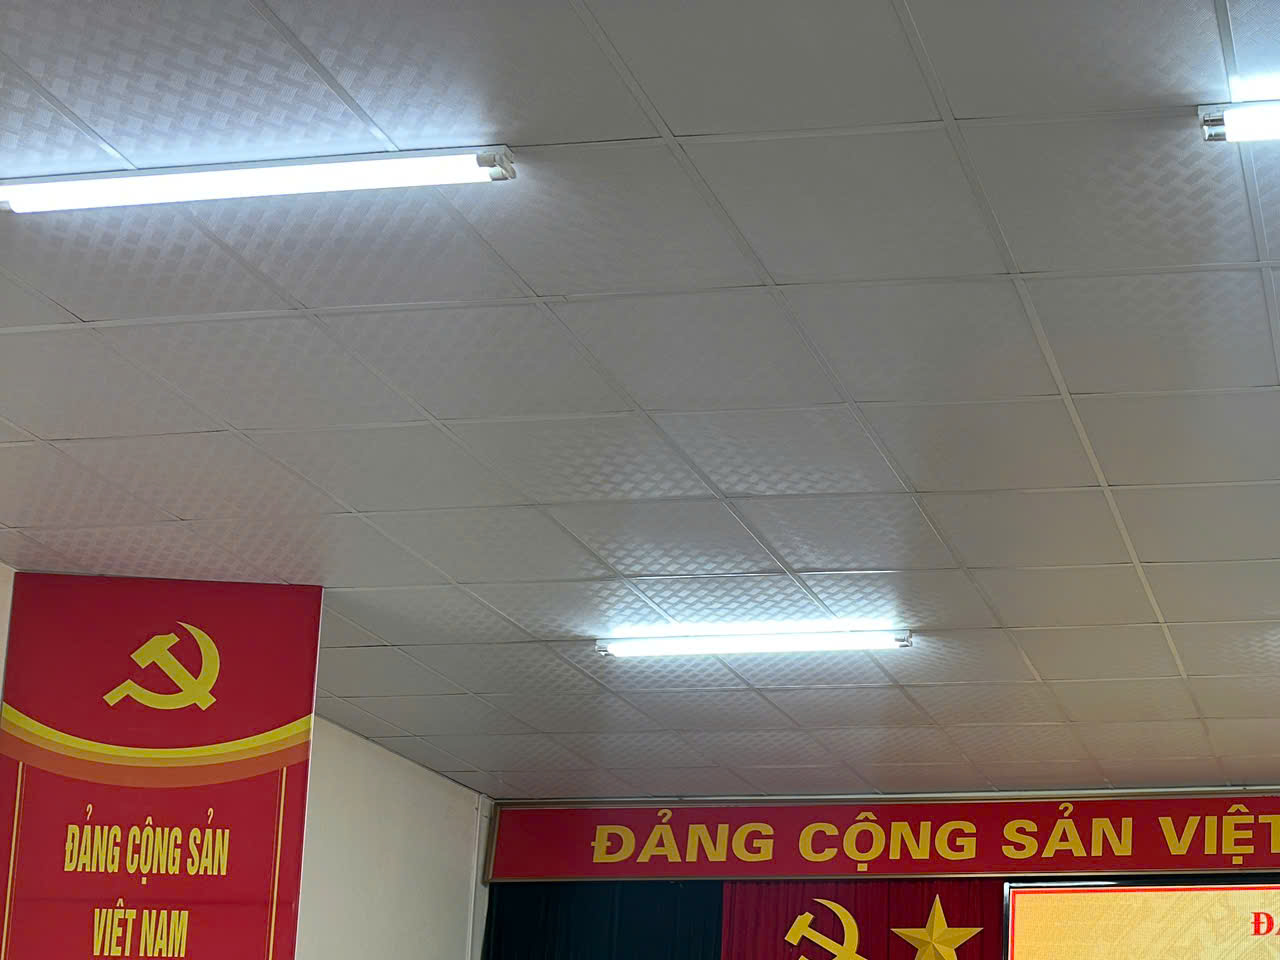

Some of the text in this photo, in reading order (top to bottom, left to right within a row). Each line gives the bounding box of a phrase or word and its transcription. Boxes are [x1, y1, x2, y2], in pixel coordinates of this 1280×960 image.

[64, 804, 230, 884] ĐẢNG CỘNG SẢN
[591, 808, 774, 862] ĐẢNG
[799, 811, 977, 871] CỘNG
[1002, 802, 1133, 858] SẢN
[139, 909, 189, 958] NAM
